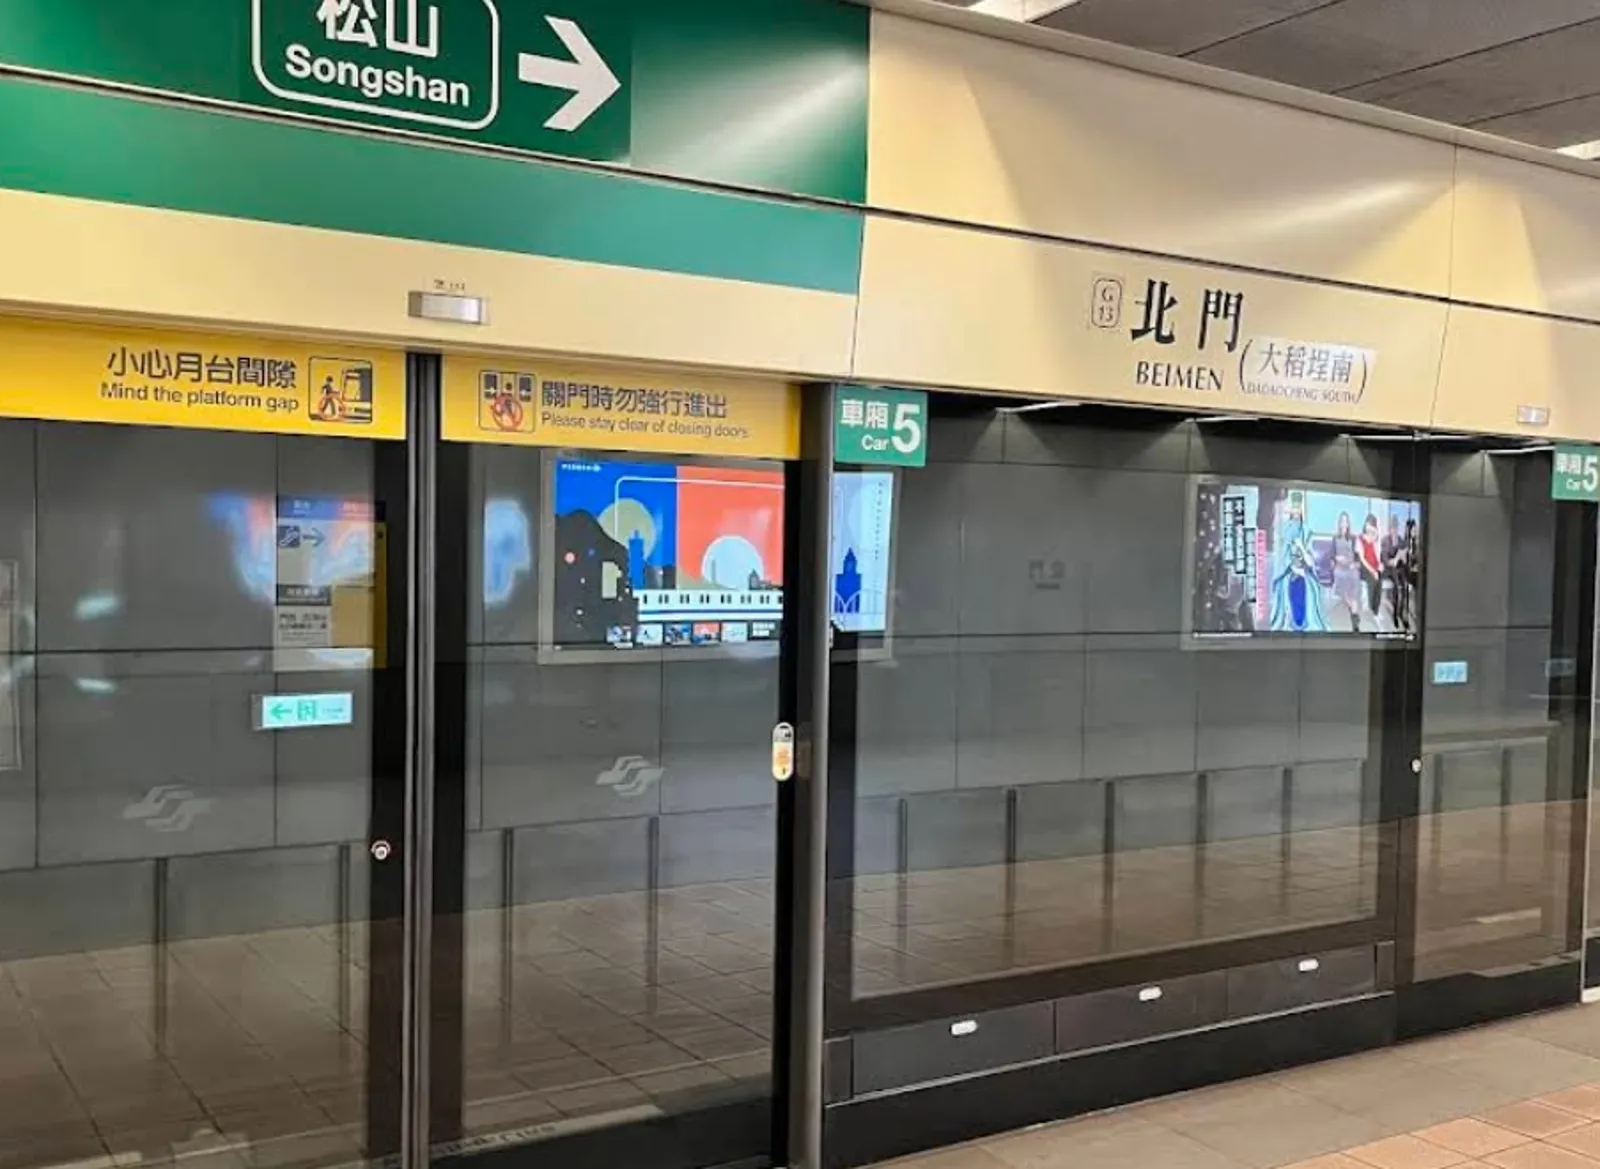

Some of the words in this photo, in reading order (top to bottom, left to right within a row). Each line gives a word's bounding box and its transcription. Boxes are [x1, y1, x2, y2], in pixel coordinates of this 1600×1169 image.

[316, 0, 438, 58] 松山
[284, 43, 470, 108] Songshan
[1101, 285, 1114, 302] G
[1099, 304, 1114, 322] 13
[1130, 278, 1244, 353] 北門
[107, 346, 297, 389] 小心月台間隙
[1136, 360, 1225, 391] BEIMEN
[101, 382, 148, 401] Mind
[154, 386, 183, 403] the
[187, 389, 261, 408] platform
[266, 395, 299, 416] gap
[541, 380, 727, 419] 關門時勿強行進出
[541, 411, 586, 428] Please
[588, 415, 615, 432] stay
[618, 417, 650, 433] clear
[652, 420, 665, 433] of
[667, 421, 711, 439] closing
[714, 424, 749, 439] doors
[840, 398, 889, 430] 車廂
[890, 403, 921, 453] 5
[861, 433, 890, 451] Car
[1582, 455, 1599, 492] 5
